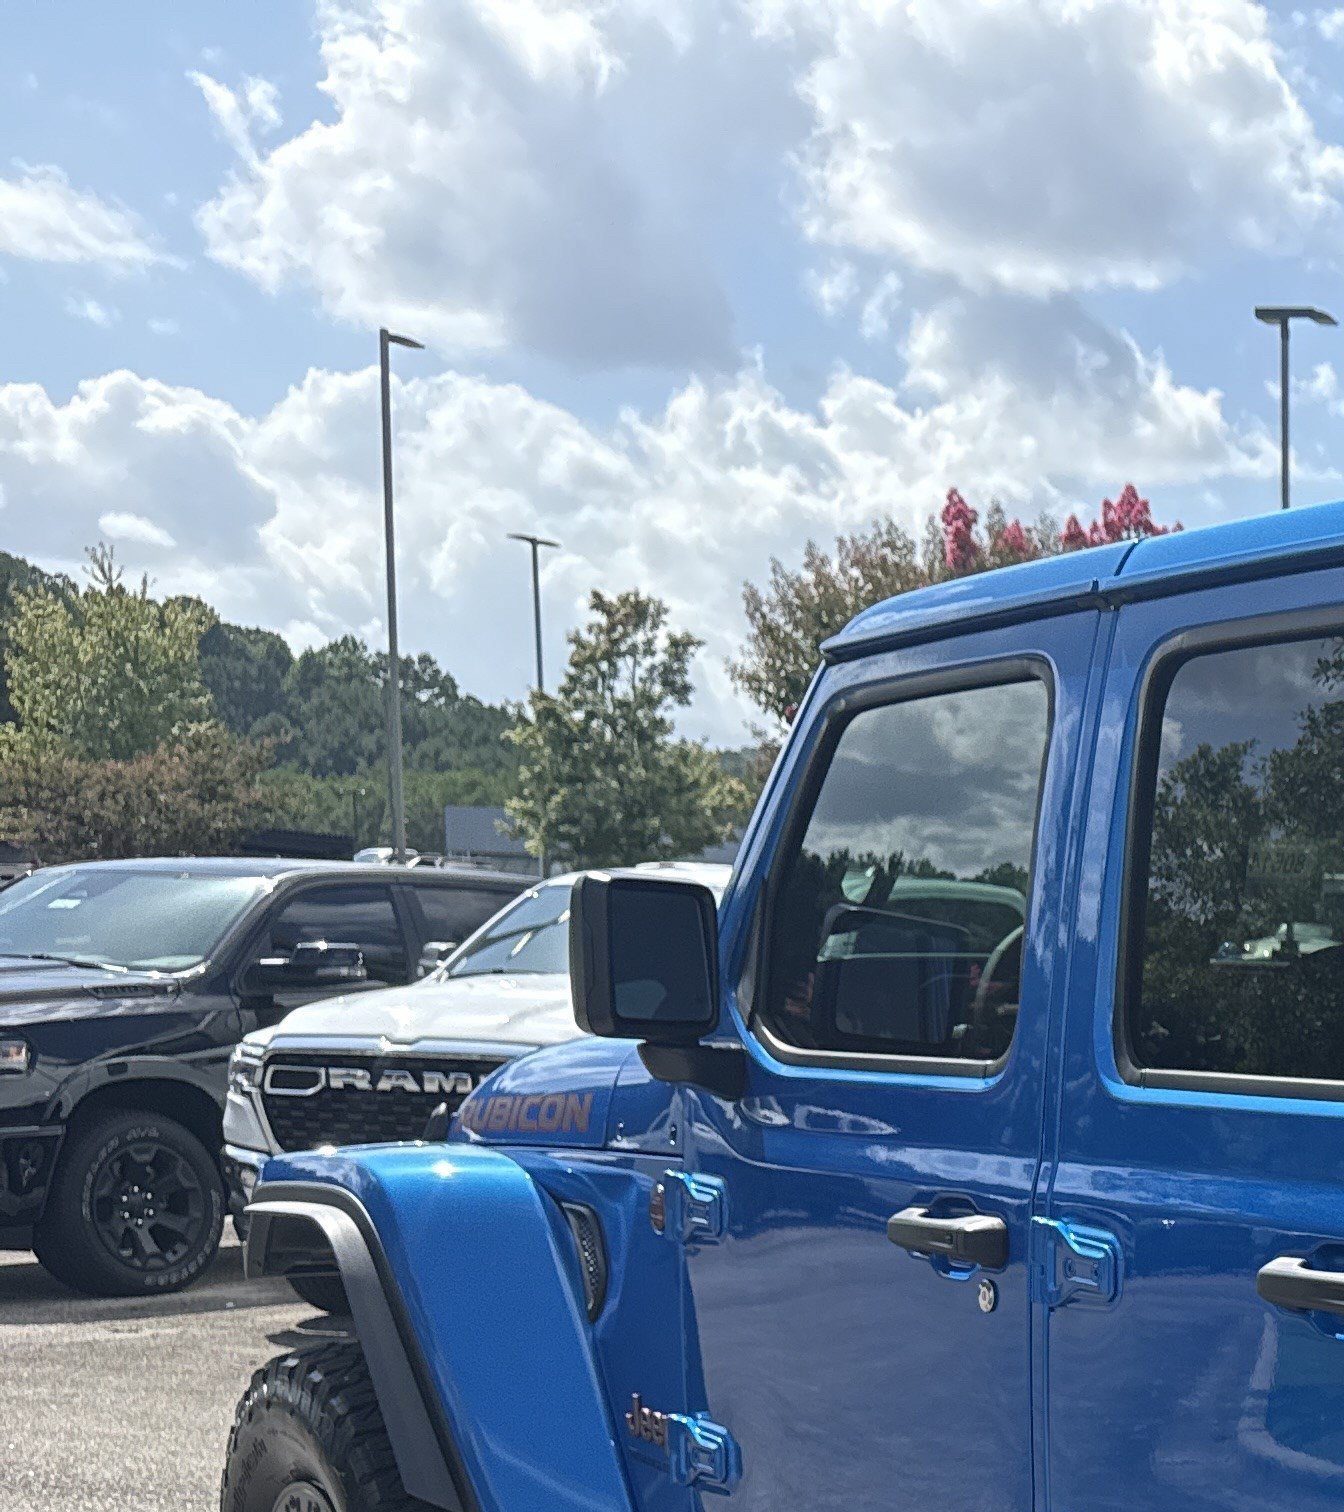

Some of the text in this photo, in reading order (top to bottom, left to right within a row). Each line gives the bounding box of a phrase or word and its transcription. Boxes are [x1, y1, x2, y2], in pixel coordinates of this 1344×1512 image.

[328, 1067, 473, 1094] RAM
[460, 1092, 594, 1134] RUBICON
[625, 1391, 670, 1457] Jeep
